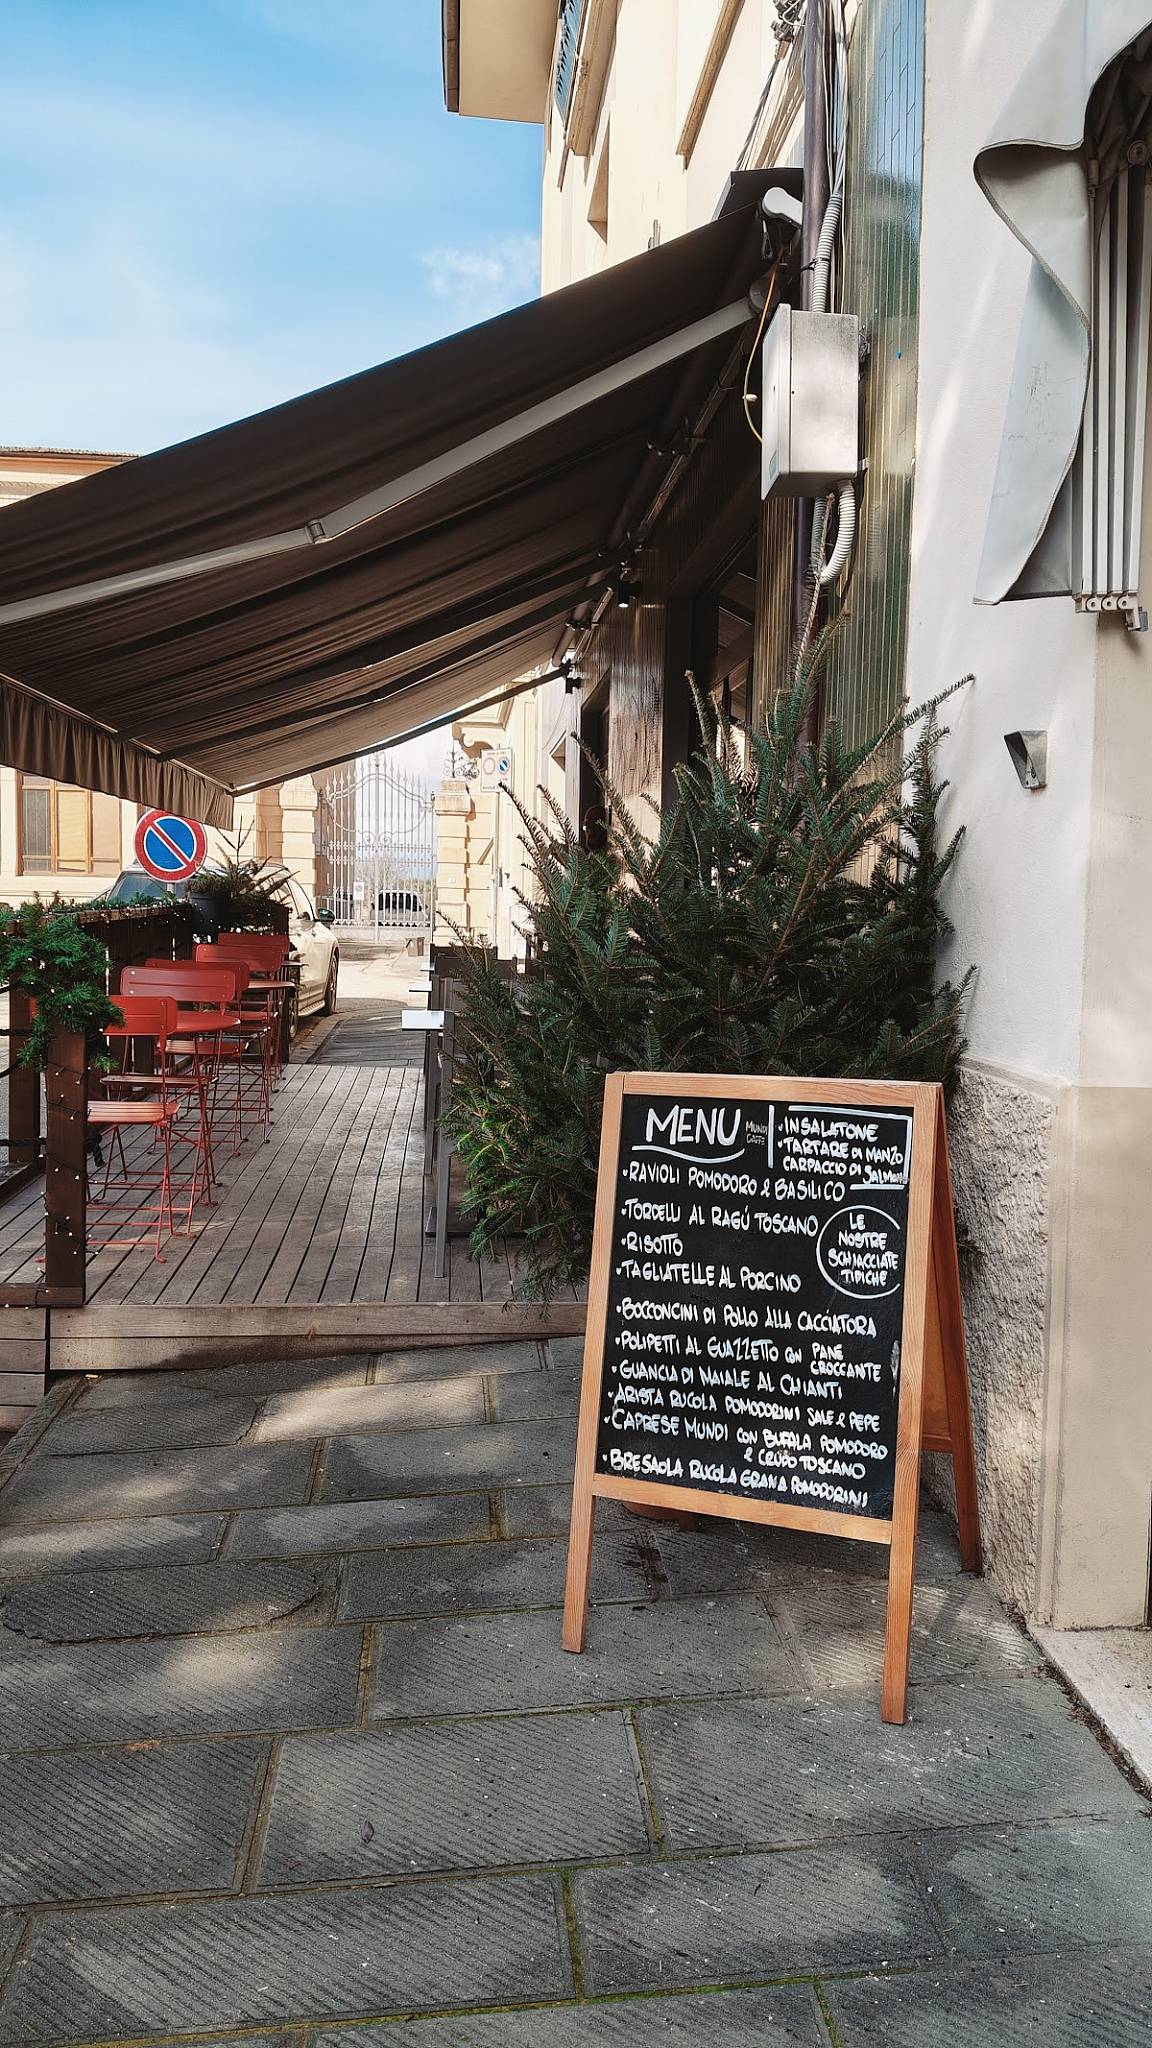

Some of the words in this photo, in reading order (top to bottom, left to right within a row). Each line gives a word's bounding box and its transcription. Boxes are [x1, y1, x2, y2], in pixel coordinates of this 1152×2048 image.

[645, 1104, 741, 1146] MENU
[745, 1120, 768, 1135] MUNDI
[784, 1116, 879, 1142] INSALATONE
[782, 1155, 847, 1176] CARPACCIO
[848, 1162, 862, 1176] DI
[783, 1136, 849, 1159] TARTARE
[851, 1146, 863, 1160] DI
[865, 1145, 904, 1166] MANZO
[629, 1161, 680, 1184] RAVIOLI
[688, 1166, 758, 1196] POMODORO
[774, 1177, 846, 1202] BASILICO
[624, 1198, 681, 1223] TORDELLI
[688, 1203, 706, 1226] AL
[754, 1212, 819, 1237] TOSCANO
[850, 1212, 866, 1231] LE
[626, 1231, 683, 1256] RISOTTO
[838, 1229, 888, 1250] NOSTRE
[828, 1247, 899, 1270] SCHIACCIATE
[621, 1259, 715, 1287] TAGLIATELLE
[718, 1264, 737, 1289] AL
[740, 1266, 802, 1293] PORCINO
[840, 1269, 888, 1287] TIPICHE
[621, 1297, 698, 1322] BOCCONCINI
[703, 1306, 716, 1325] DI
[723, 1304, 759, 1328] POLLO
[764, 1305, 792, 1330] ALLA
[797, 1309, 877, 1338] CACCIATORA
[620, 1330, 680, 1356] POLIPETTI
[685, 1334, 703, 1356] AL
[707, 1336, 779, 1362] GUAZZETTO
[784, 1346, 803, 1364] CON
[811, 1342, 844, 1360] PANE
[619, 1359, 679, 1382] GUANCIA
[681, 1366, 694, 1385] DI
[699, 1365, 751, 1389] MAIALE
[757, 1370, 775, 1393] AL
[780, 1373, 843, 1400] CHIANTI
[810, 1360, 882, 1383] CROCCANTE
[613, 1382, 664, 1406] ARISTA
[669, 1389, 717, 1412] RUCOLA
[724, 1395, 800, 1421] POMODORINI
[806, 1406, 835, 1427] SALE
[848, 1411, 881, 1433] PEPE
[611, 1408, 680, 1436] CAPRESE
[684, 1416, 729, 1441] MUNDI
[736, 1427, 758, 1445] CON
[762, 1428, 812, 1451] BUFALA
[820, 1434, 888, 1460] POMODORO
[610, 1448, 684, 1478] BRESAOLA
[688, 1459, 738, 1484] RUCOLA
[740, 1469, 788, 1492] GRANA
[790, 1475, 868, 1508] POMODORINI
[758, 1448, 798, 1469] CRUDO
[799, 1455, 866, 1480] TOSCANO
